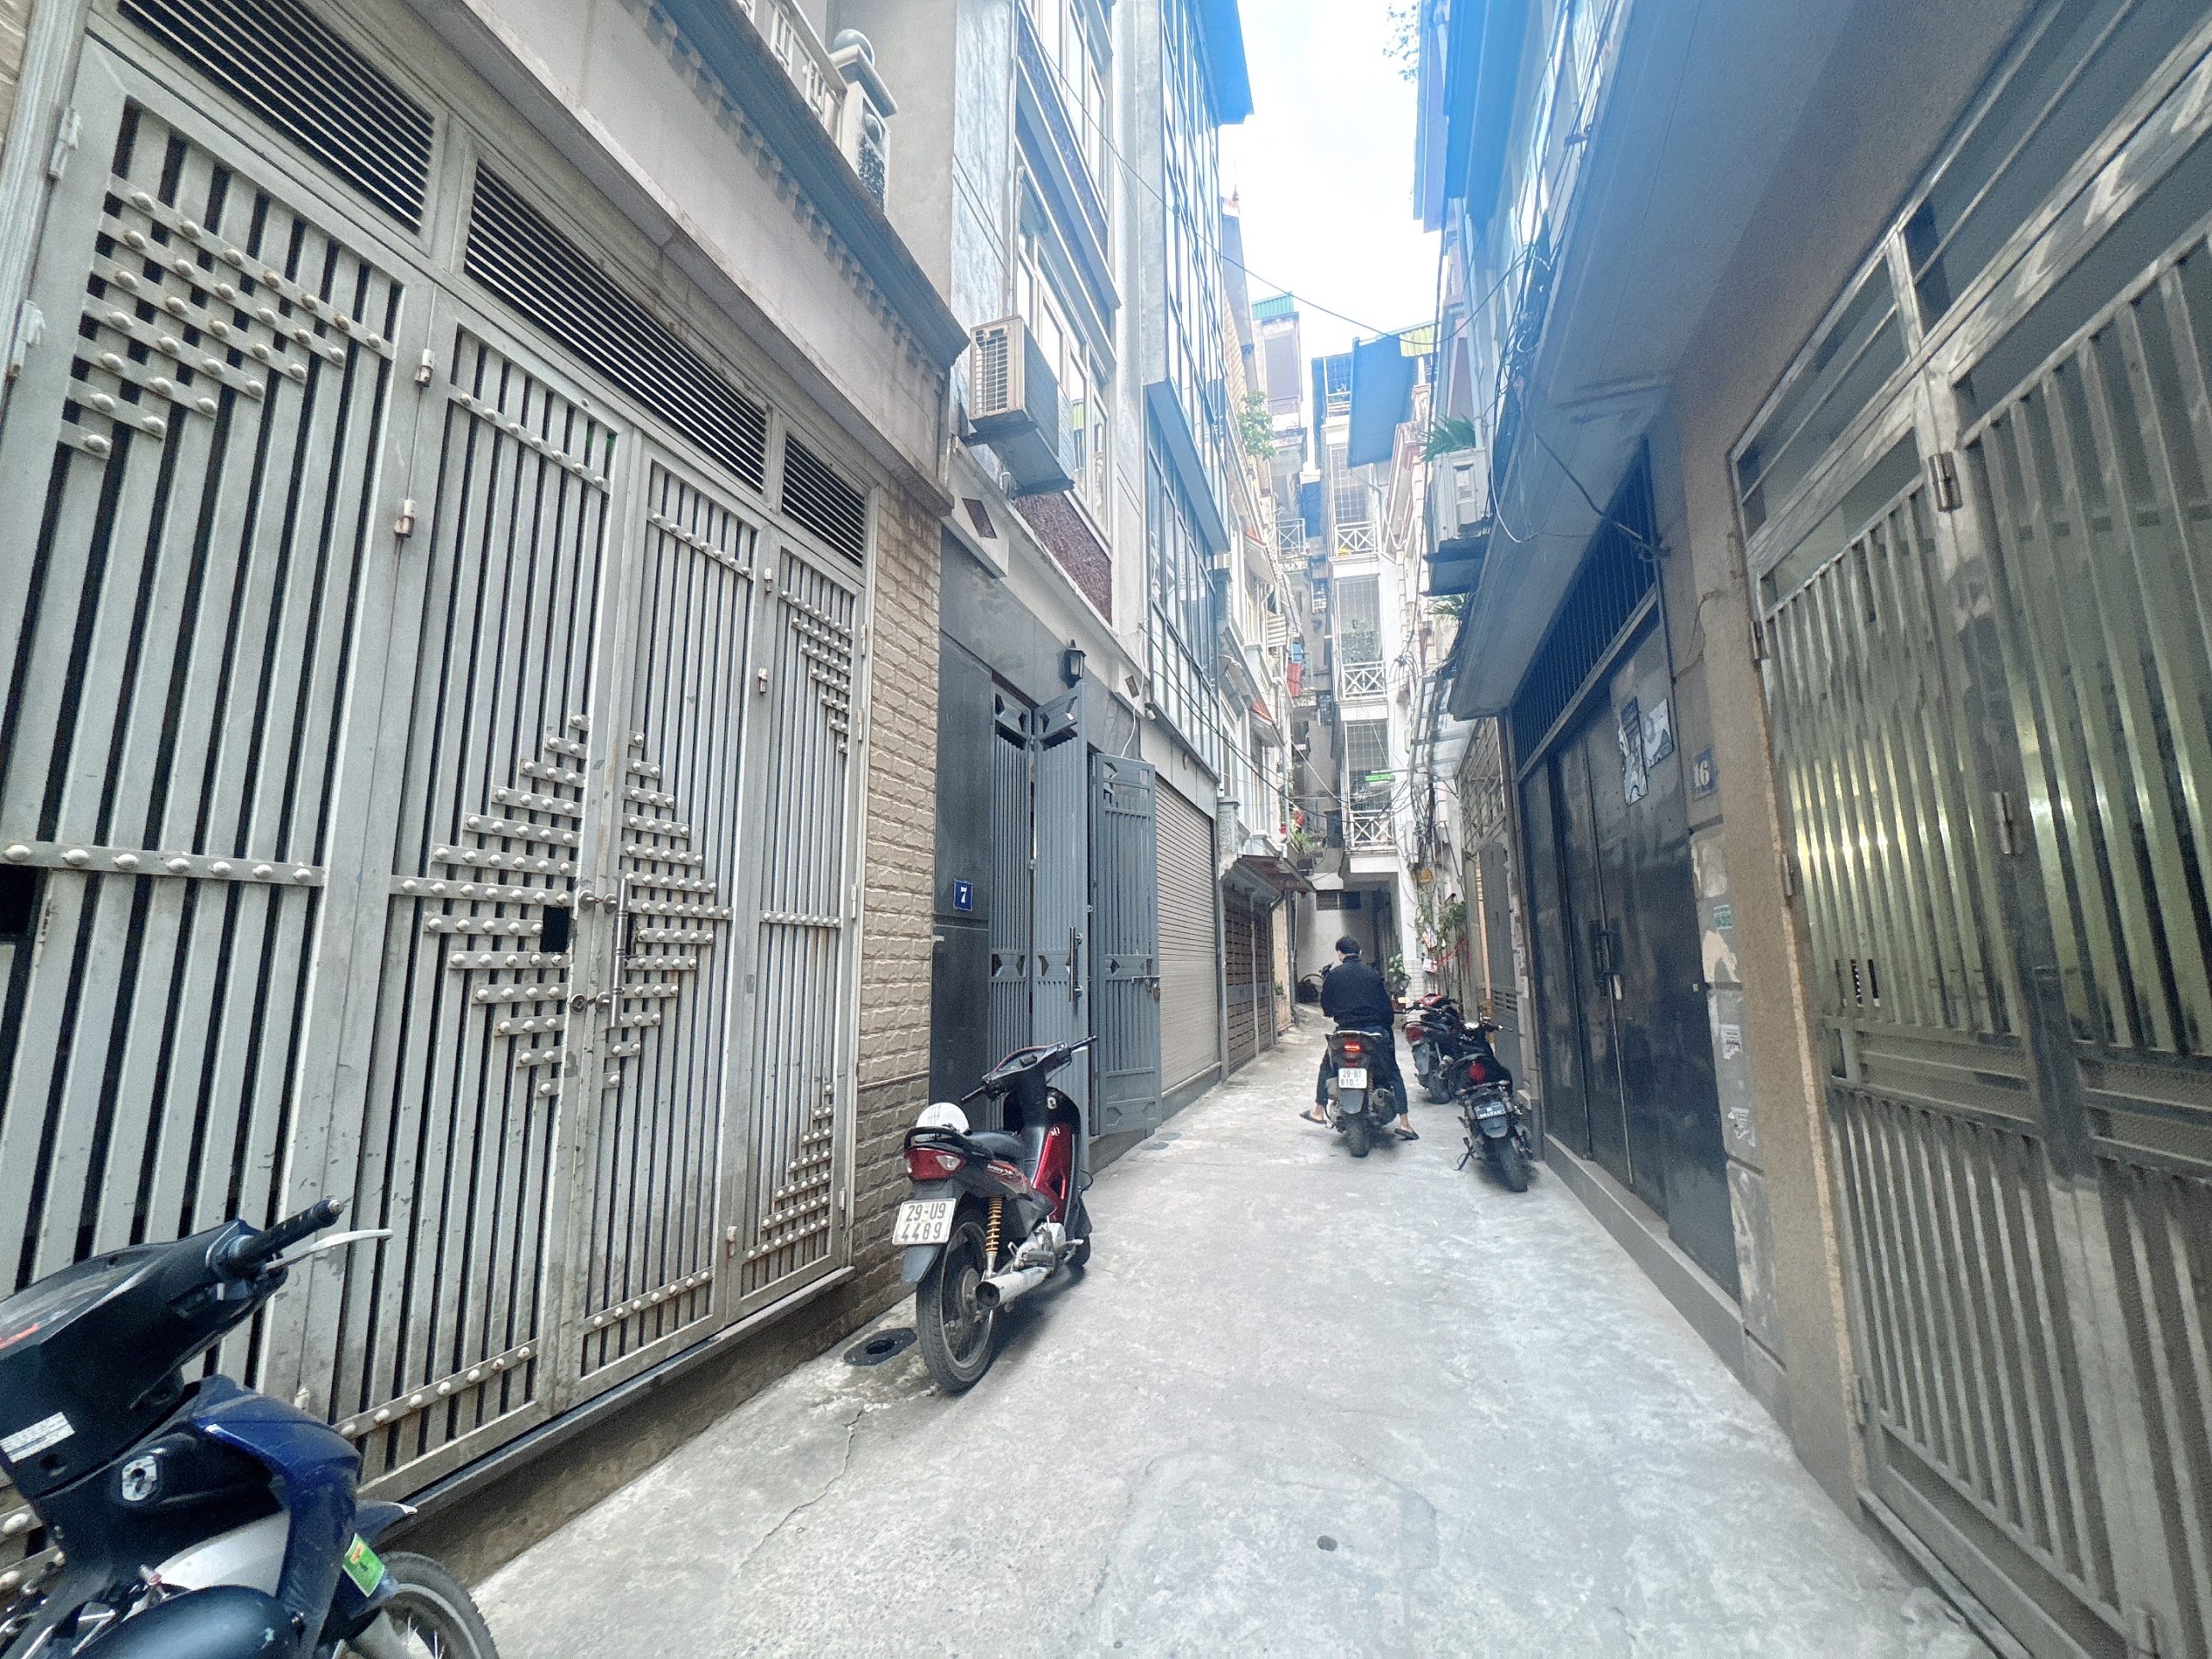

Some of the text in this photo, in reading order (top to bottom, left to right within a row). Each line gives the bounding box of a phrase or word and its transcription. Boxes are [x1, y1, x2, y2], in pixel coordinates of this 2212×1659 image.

[1694, 760, 1710, 787] 16
[960, 886, 968, 904] 7
[906, 1202, 946, 1222] 29-U9
[901, 1222, 943, 1242] 4489
